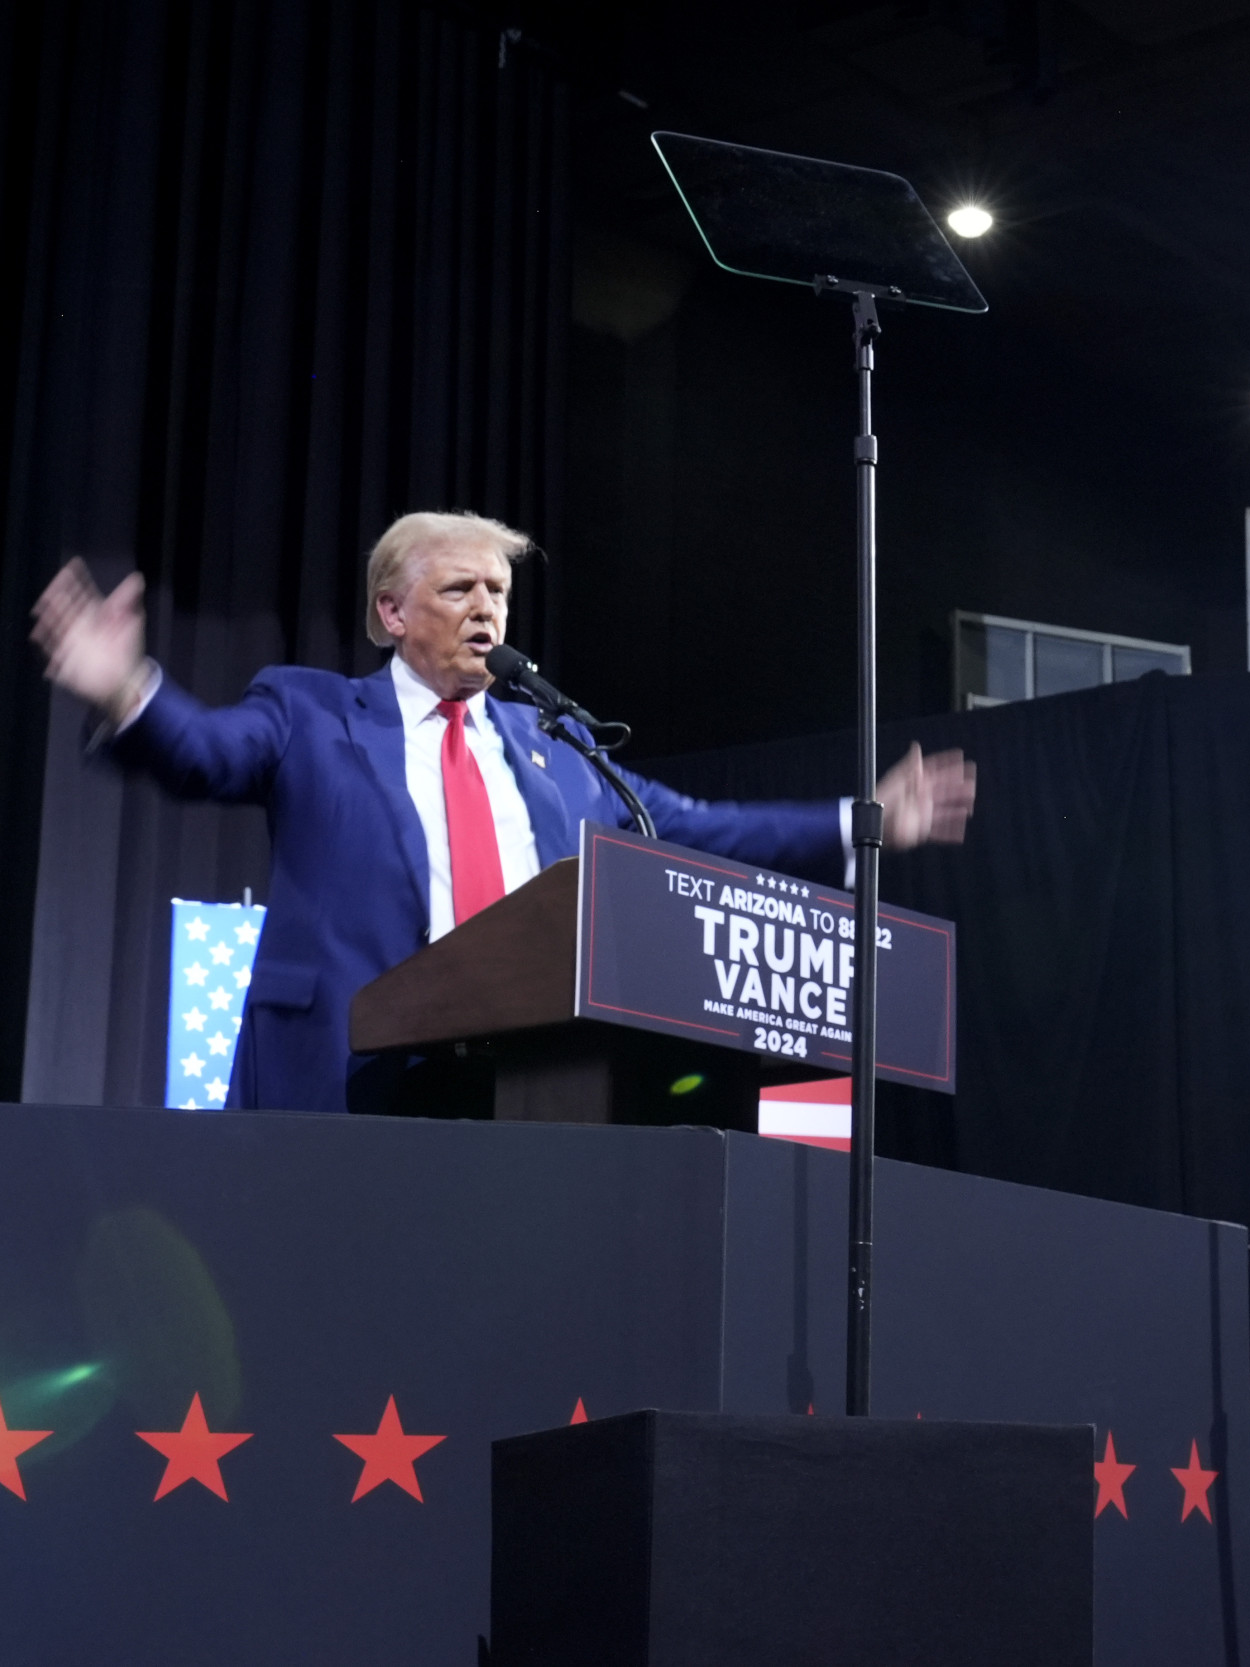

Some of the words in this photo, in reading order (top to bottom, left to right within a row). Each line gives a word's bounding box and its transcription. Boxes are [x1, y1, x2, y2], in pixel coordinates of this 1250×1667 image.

[664, 869, 715, 902] TEXT
[719, 884, 807, 927] ARIZONA
[809, 908, 835, 934] TO
[714, 959, 847, 1026] VANCE
[703, 999, 735, 1016] MAKE
[736, 1007, 783, 1028] AMERICA
[785, 1017, 819, 1036] GREAT
[820, 1026, 853, 1043] AGAIN
[754, 1026, 807, 1058] 2024
